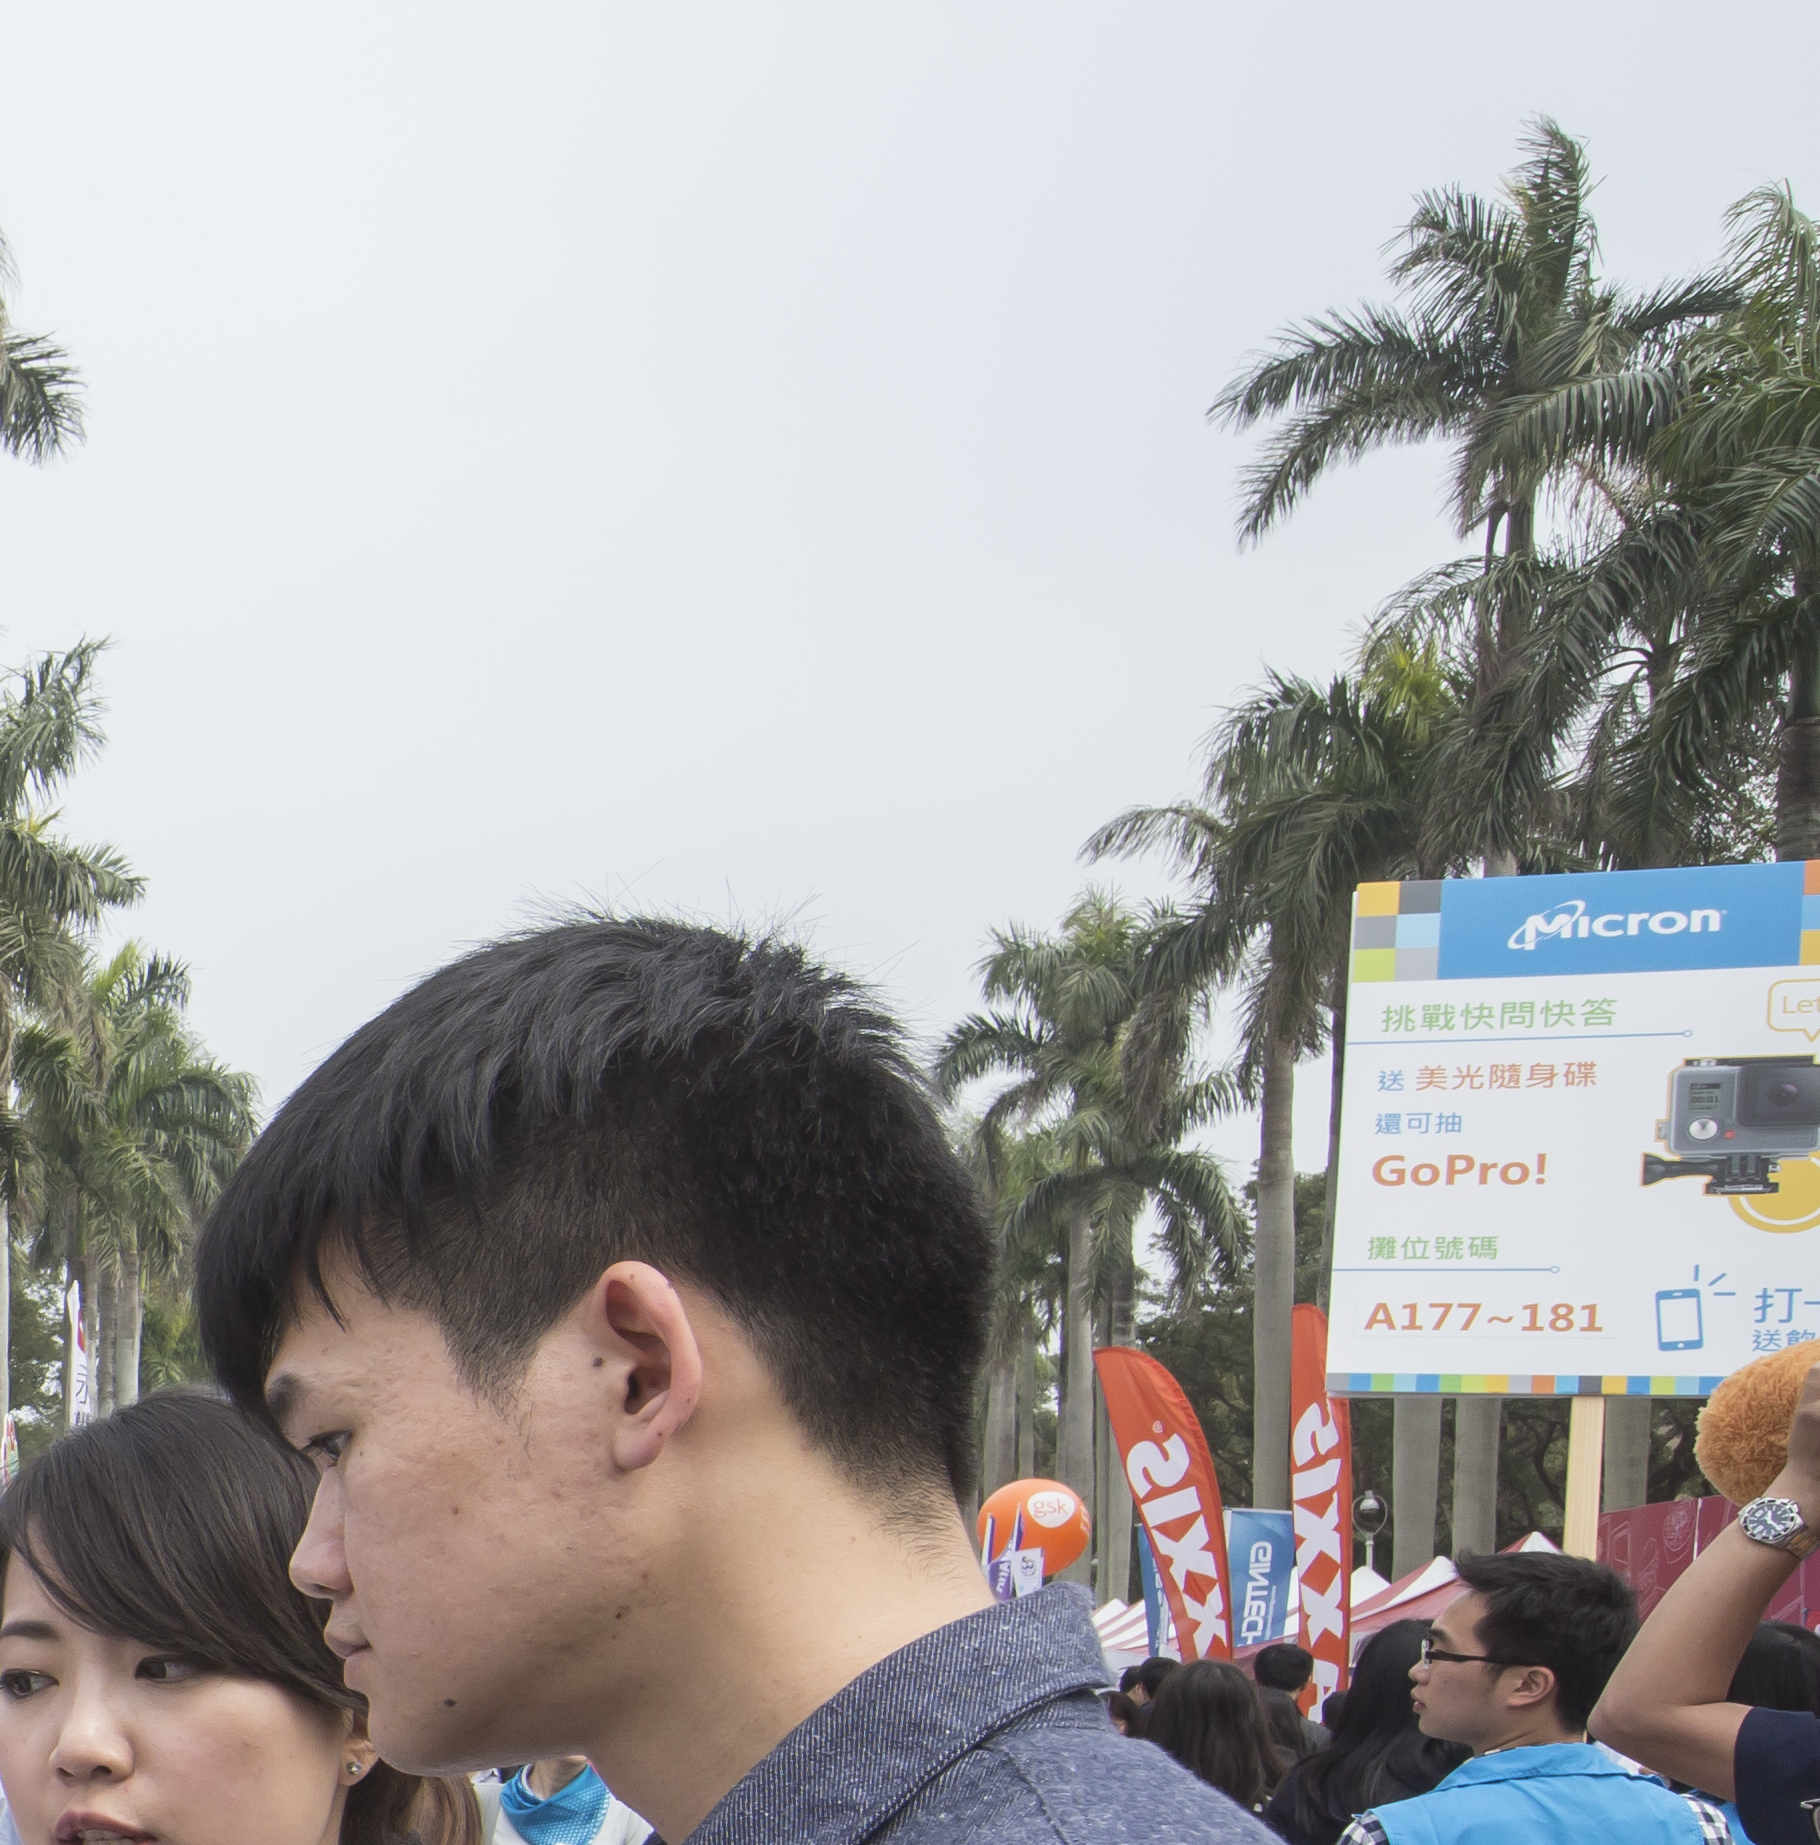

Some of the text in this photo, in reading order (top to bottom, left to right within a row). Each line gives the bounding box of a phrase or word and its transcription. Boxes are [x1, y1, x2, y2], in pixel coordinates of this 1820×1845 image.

[1507, 899, 1722, 951] Micron
[1381, 997, 1619, 1033] 挑戰快問快答
[1376, 1061, 1599, 1093] 送 美光隨身碟
[1374, 1111, 1463, 1136] 還可抽
[1371, 1152, 1548, 1188] GoPro!
[1367, 1235, 1499, 1262] 攤位號碼
[1032, 1498, 1069, 1519] gsk
